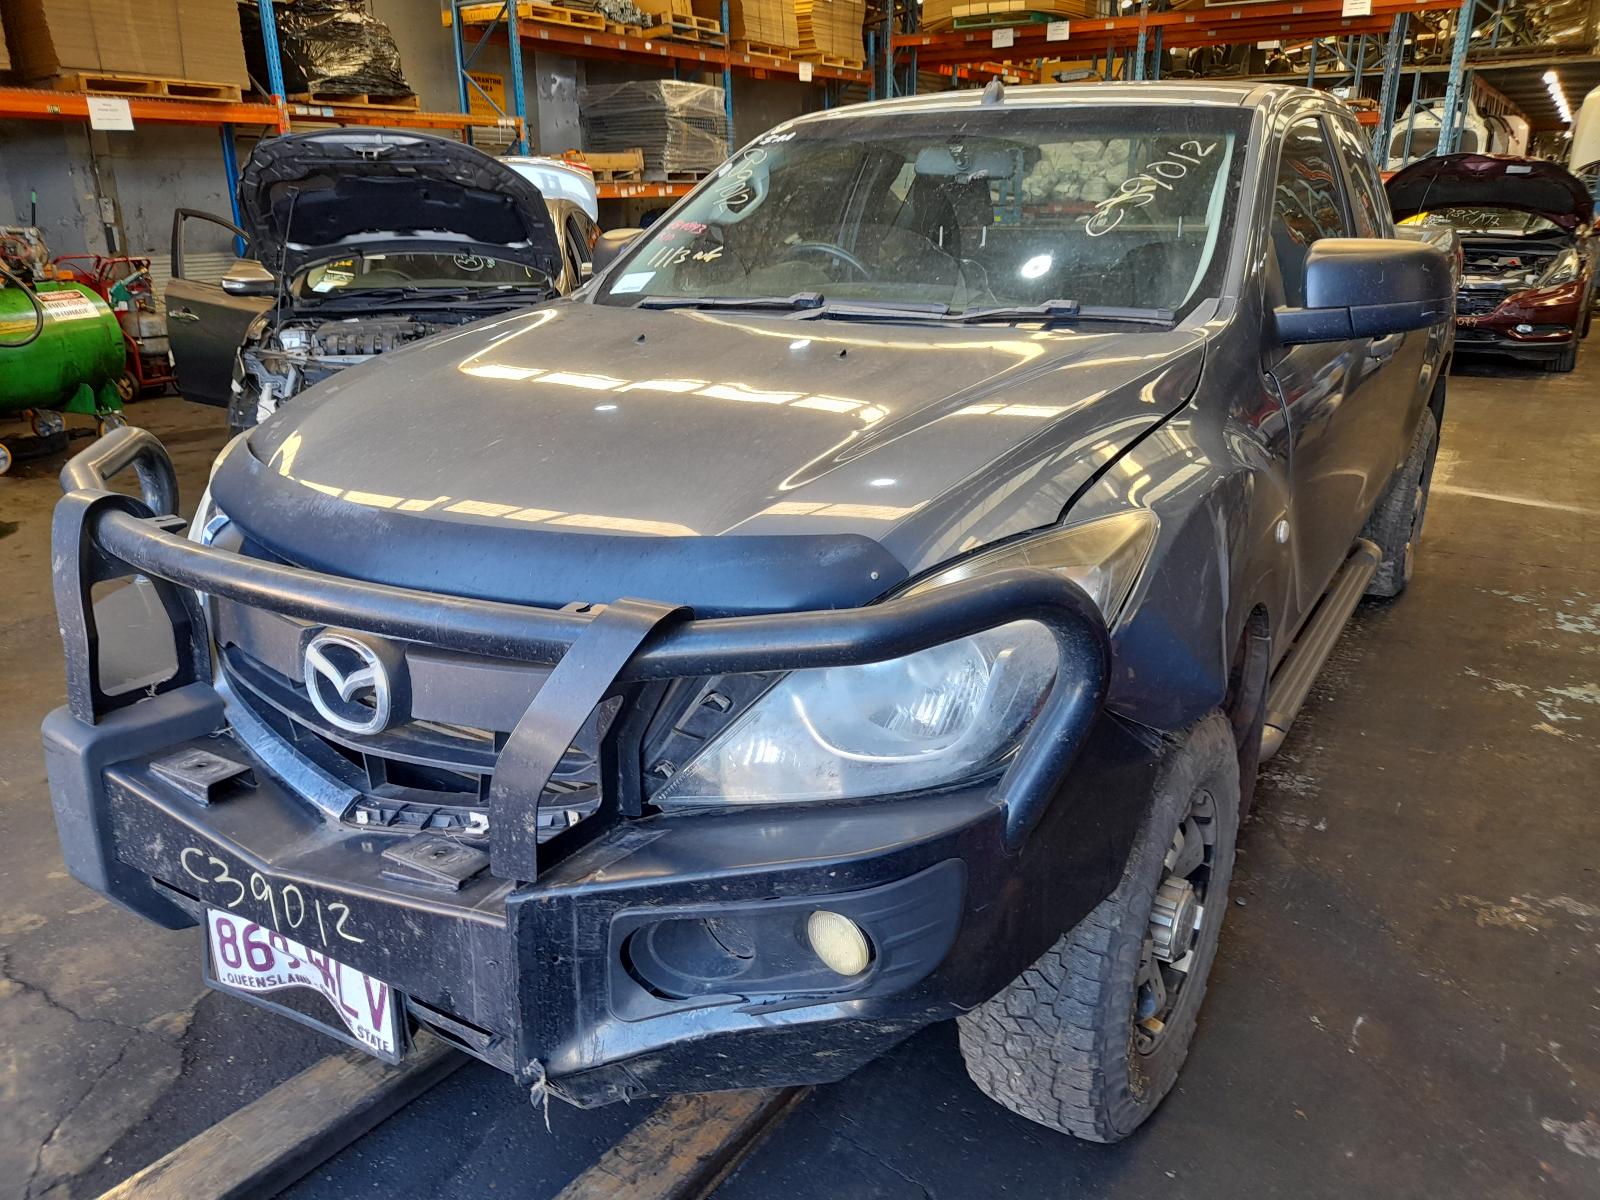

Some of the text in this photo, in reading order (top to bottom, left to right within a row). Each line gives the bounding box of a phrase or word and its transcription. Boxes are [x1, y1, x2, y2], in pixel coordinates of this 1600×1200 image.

[180, 848, 365, 947] C39012
[227, 972, 390, 1052] QUEENSLAND STATE
